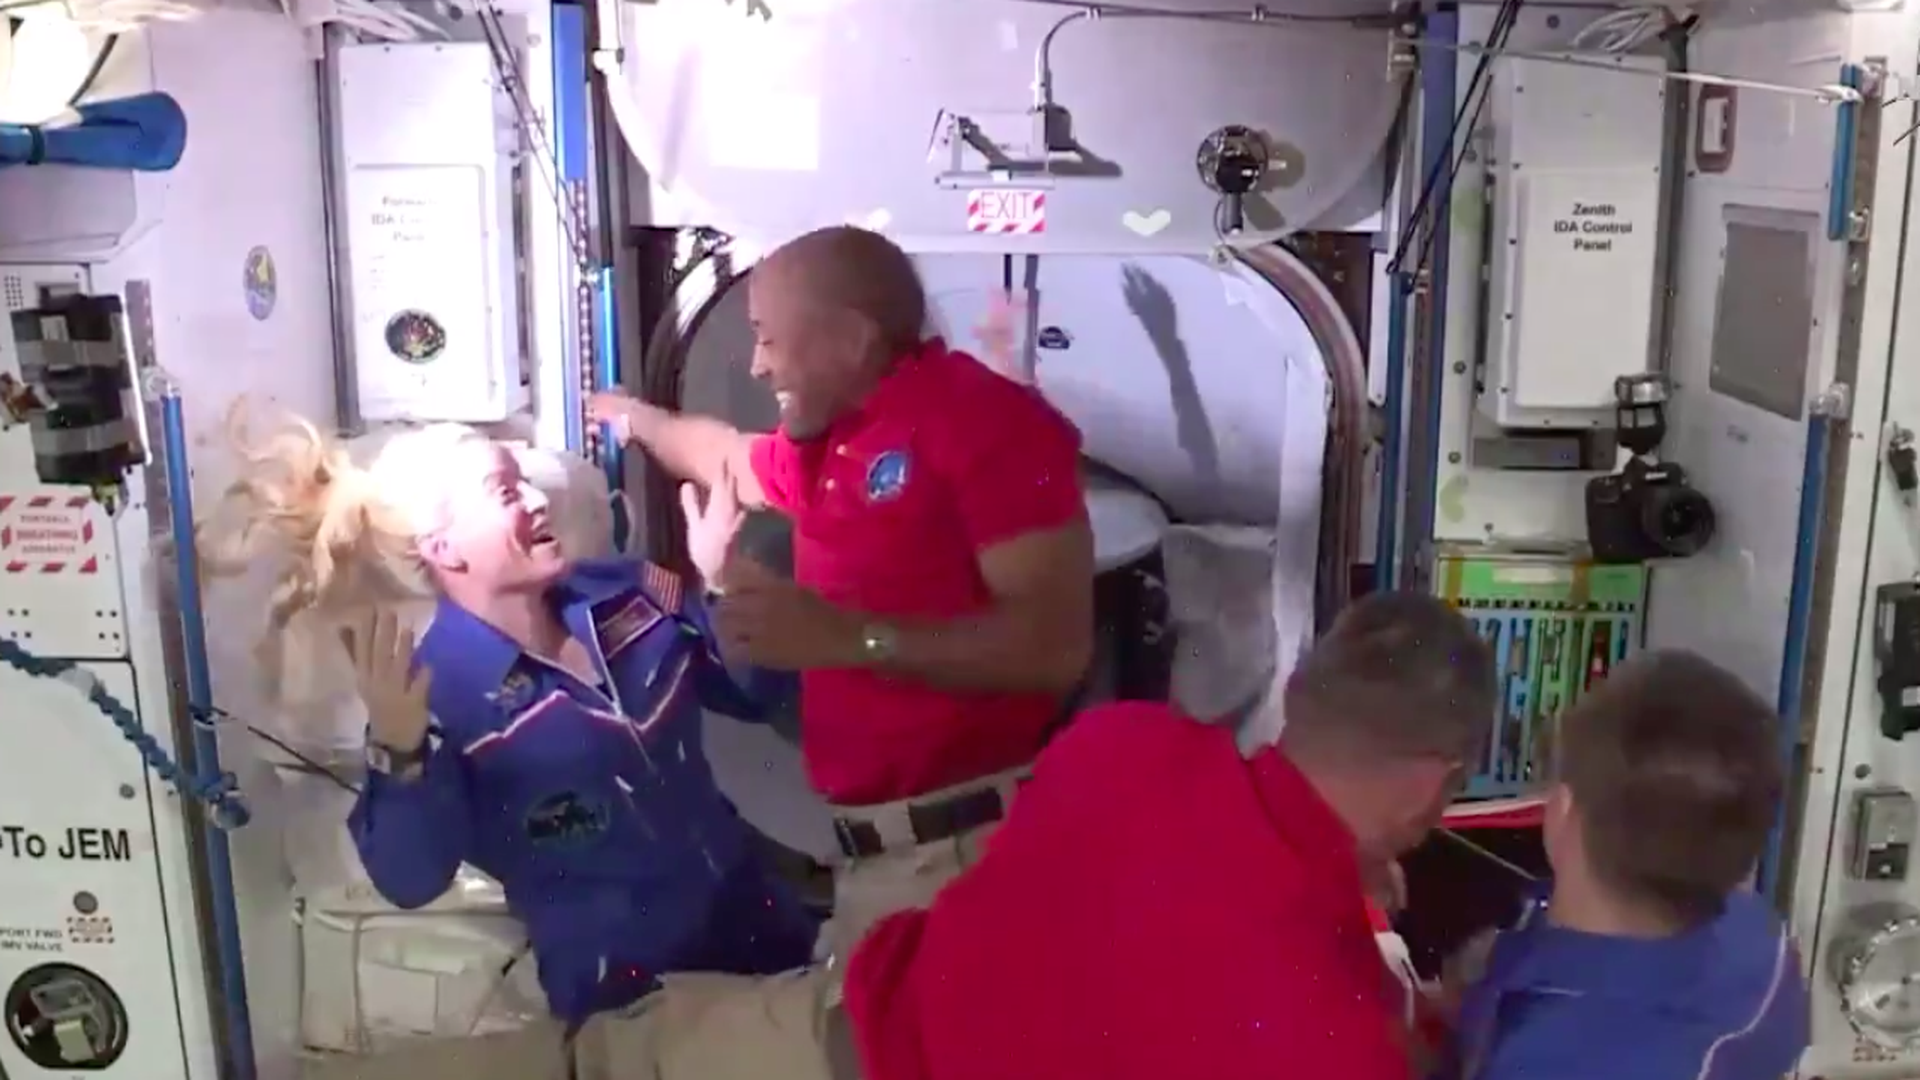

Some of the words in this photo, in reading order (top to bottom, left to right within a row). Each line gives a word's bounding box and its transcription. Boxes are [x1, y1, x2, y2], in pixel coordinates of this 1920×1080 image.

[981, 191, 1032, 219] EXIT
[1573, 203, 1616, 216] Zenith
[1554, 220, 1578, 232] IDA
[1582, 220, 1633, 233] Control
[1573, 239, 1612, 251] Panel
[2, 826, 46, 859] To
[58, 828, 130, 860] JEM
